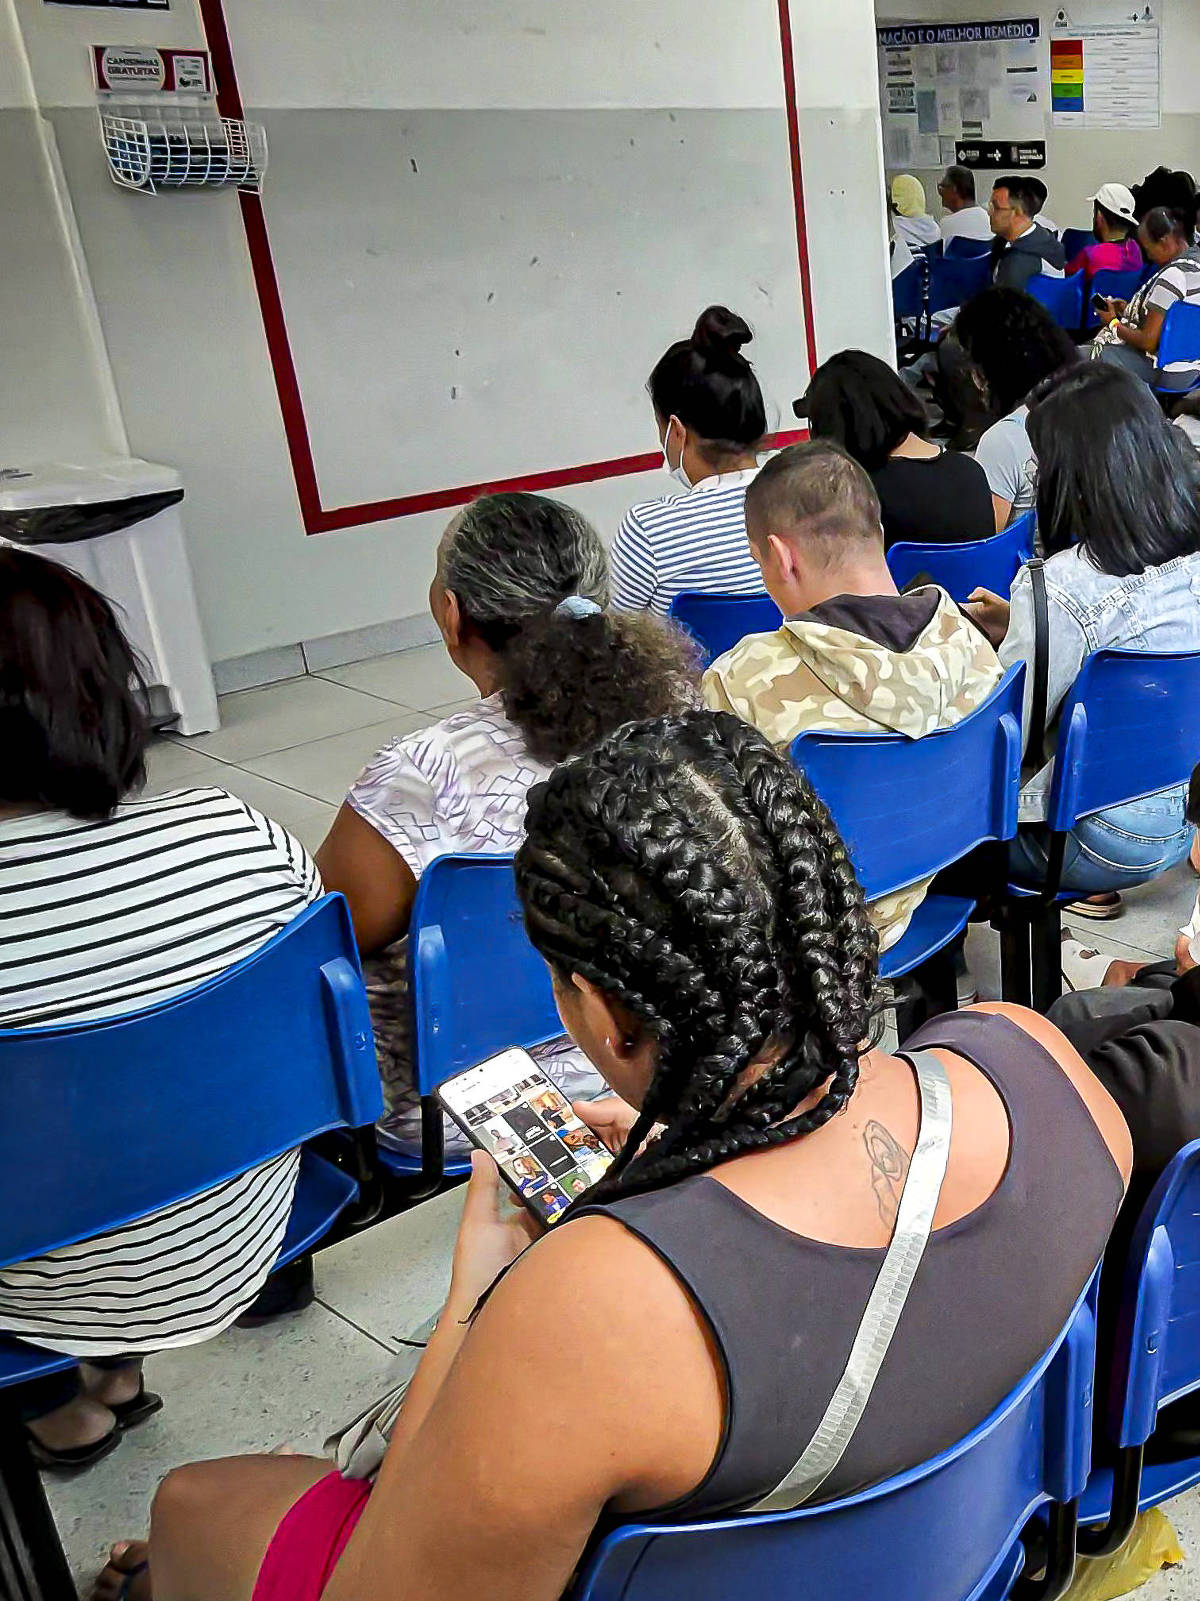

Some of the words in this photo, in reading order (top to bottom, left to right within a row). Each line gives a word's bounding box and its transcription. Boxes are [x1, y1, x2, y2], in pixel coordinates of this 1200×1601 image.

[926, 30, 935, 42] O
[937, 27, 982, 41] MELHOR
[984, 22, 1034, 39] REMÉDIO
